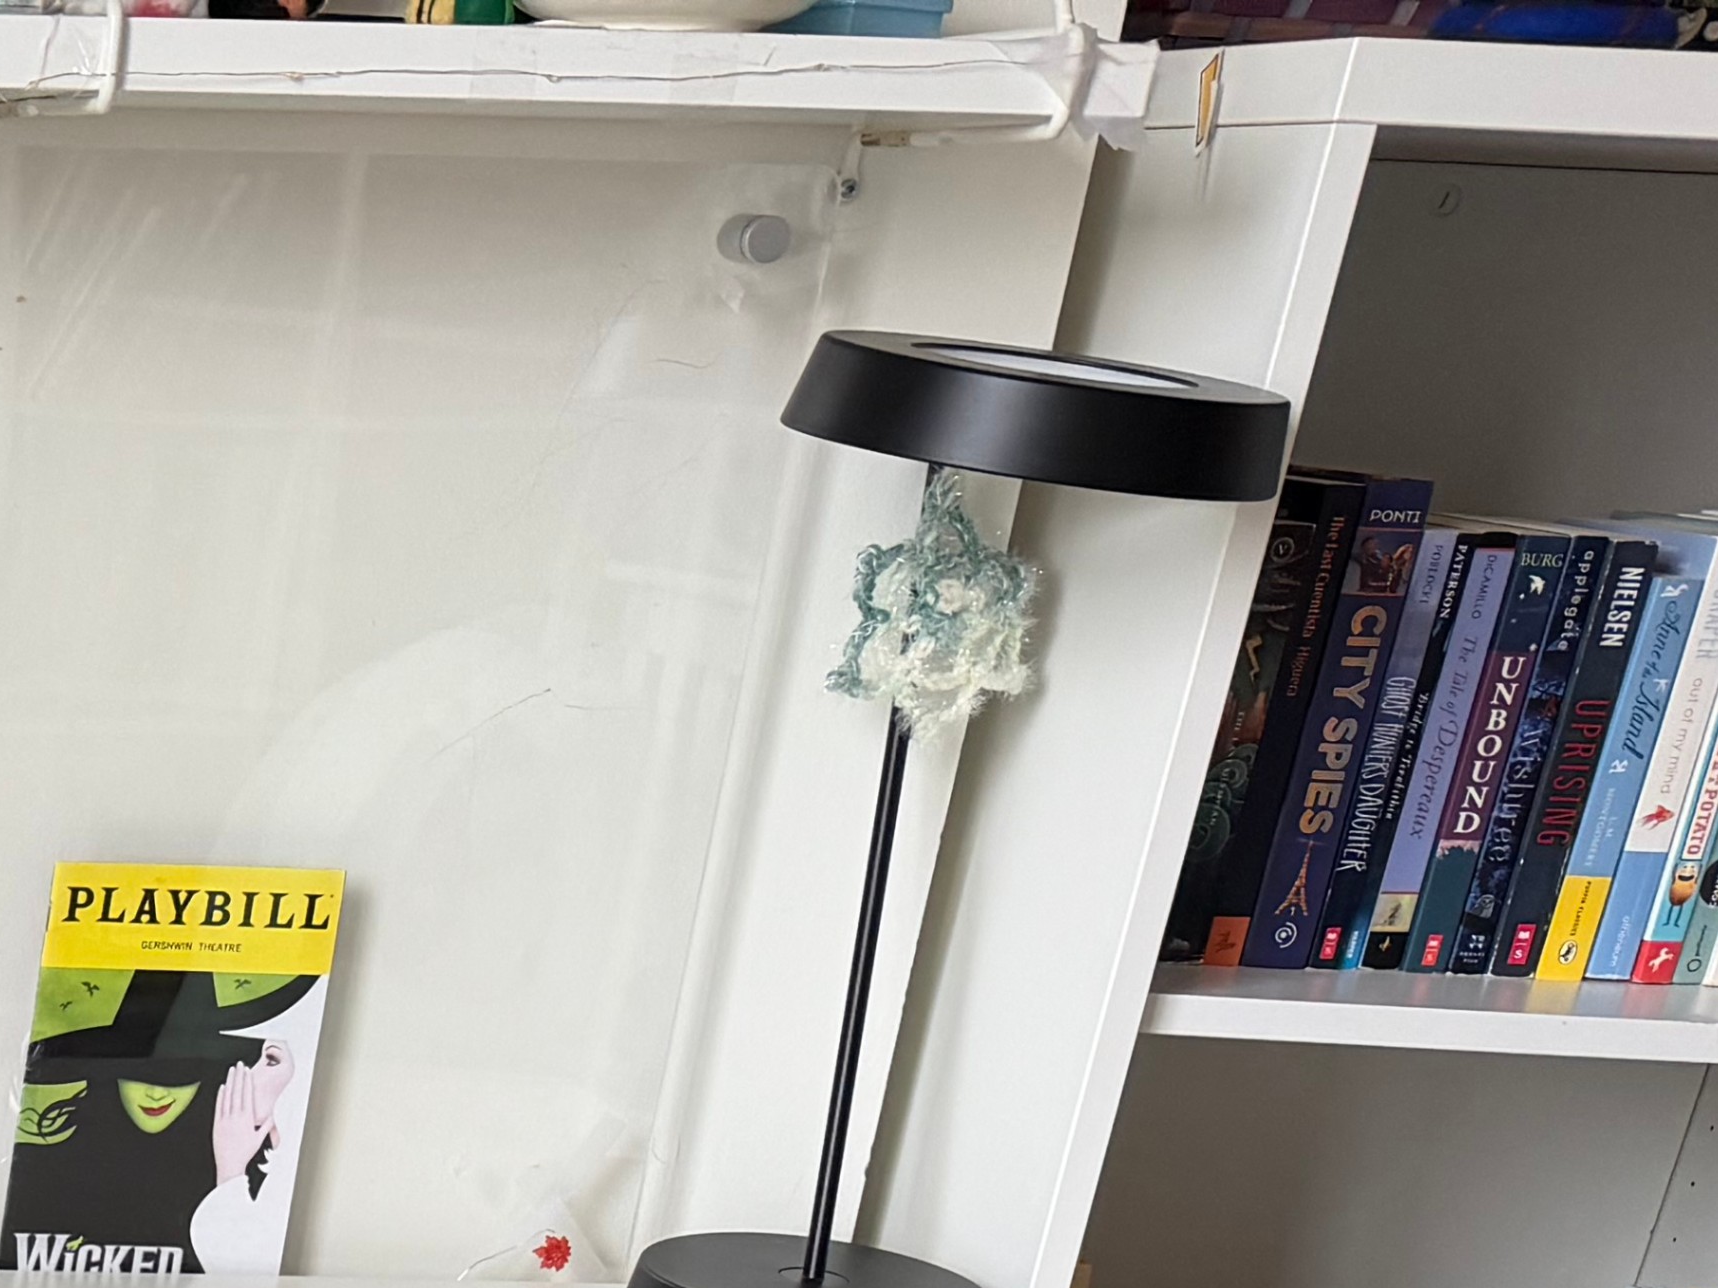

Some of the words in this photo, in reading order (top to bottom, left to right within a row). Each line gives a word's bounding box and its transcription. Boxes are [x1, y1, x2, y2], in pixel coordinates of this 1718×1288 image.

[1369, 509, 1423, 524] PONTI
[1439, 544, 1468, 619] PATERSON
[1521, 552, 1563, 568] BURG
[1557, 550, 1595, 651] applegate
[1599, 566, 1646, 647] NIELSEN
[1333, 604, 1388, 710] CITY
[1460, 636, 1477, 664] The
[1380, 676, 1418, 718] GHOST
[1439, 701, 1458, 718] of
[1689, 677, 1703, 699] out
[1680, 706, 1695, 725] of
[1453, 656, 1527, 834] UNBOUND
[1671, 728, 1688, 755] my
[1299, 716, 1359, 834] SPIES
[1410, 719, 1458, 840] Despereaux
[1536, 699, 1612, 847] UPRISING
[1686, 786, 1718, 856] POTATO
[61, 886, 332, 930] PLAYBILL
[141, 940, 193, 951] GERSHWIN
[198, 942, 242, 953] THEATRE
